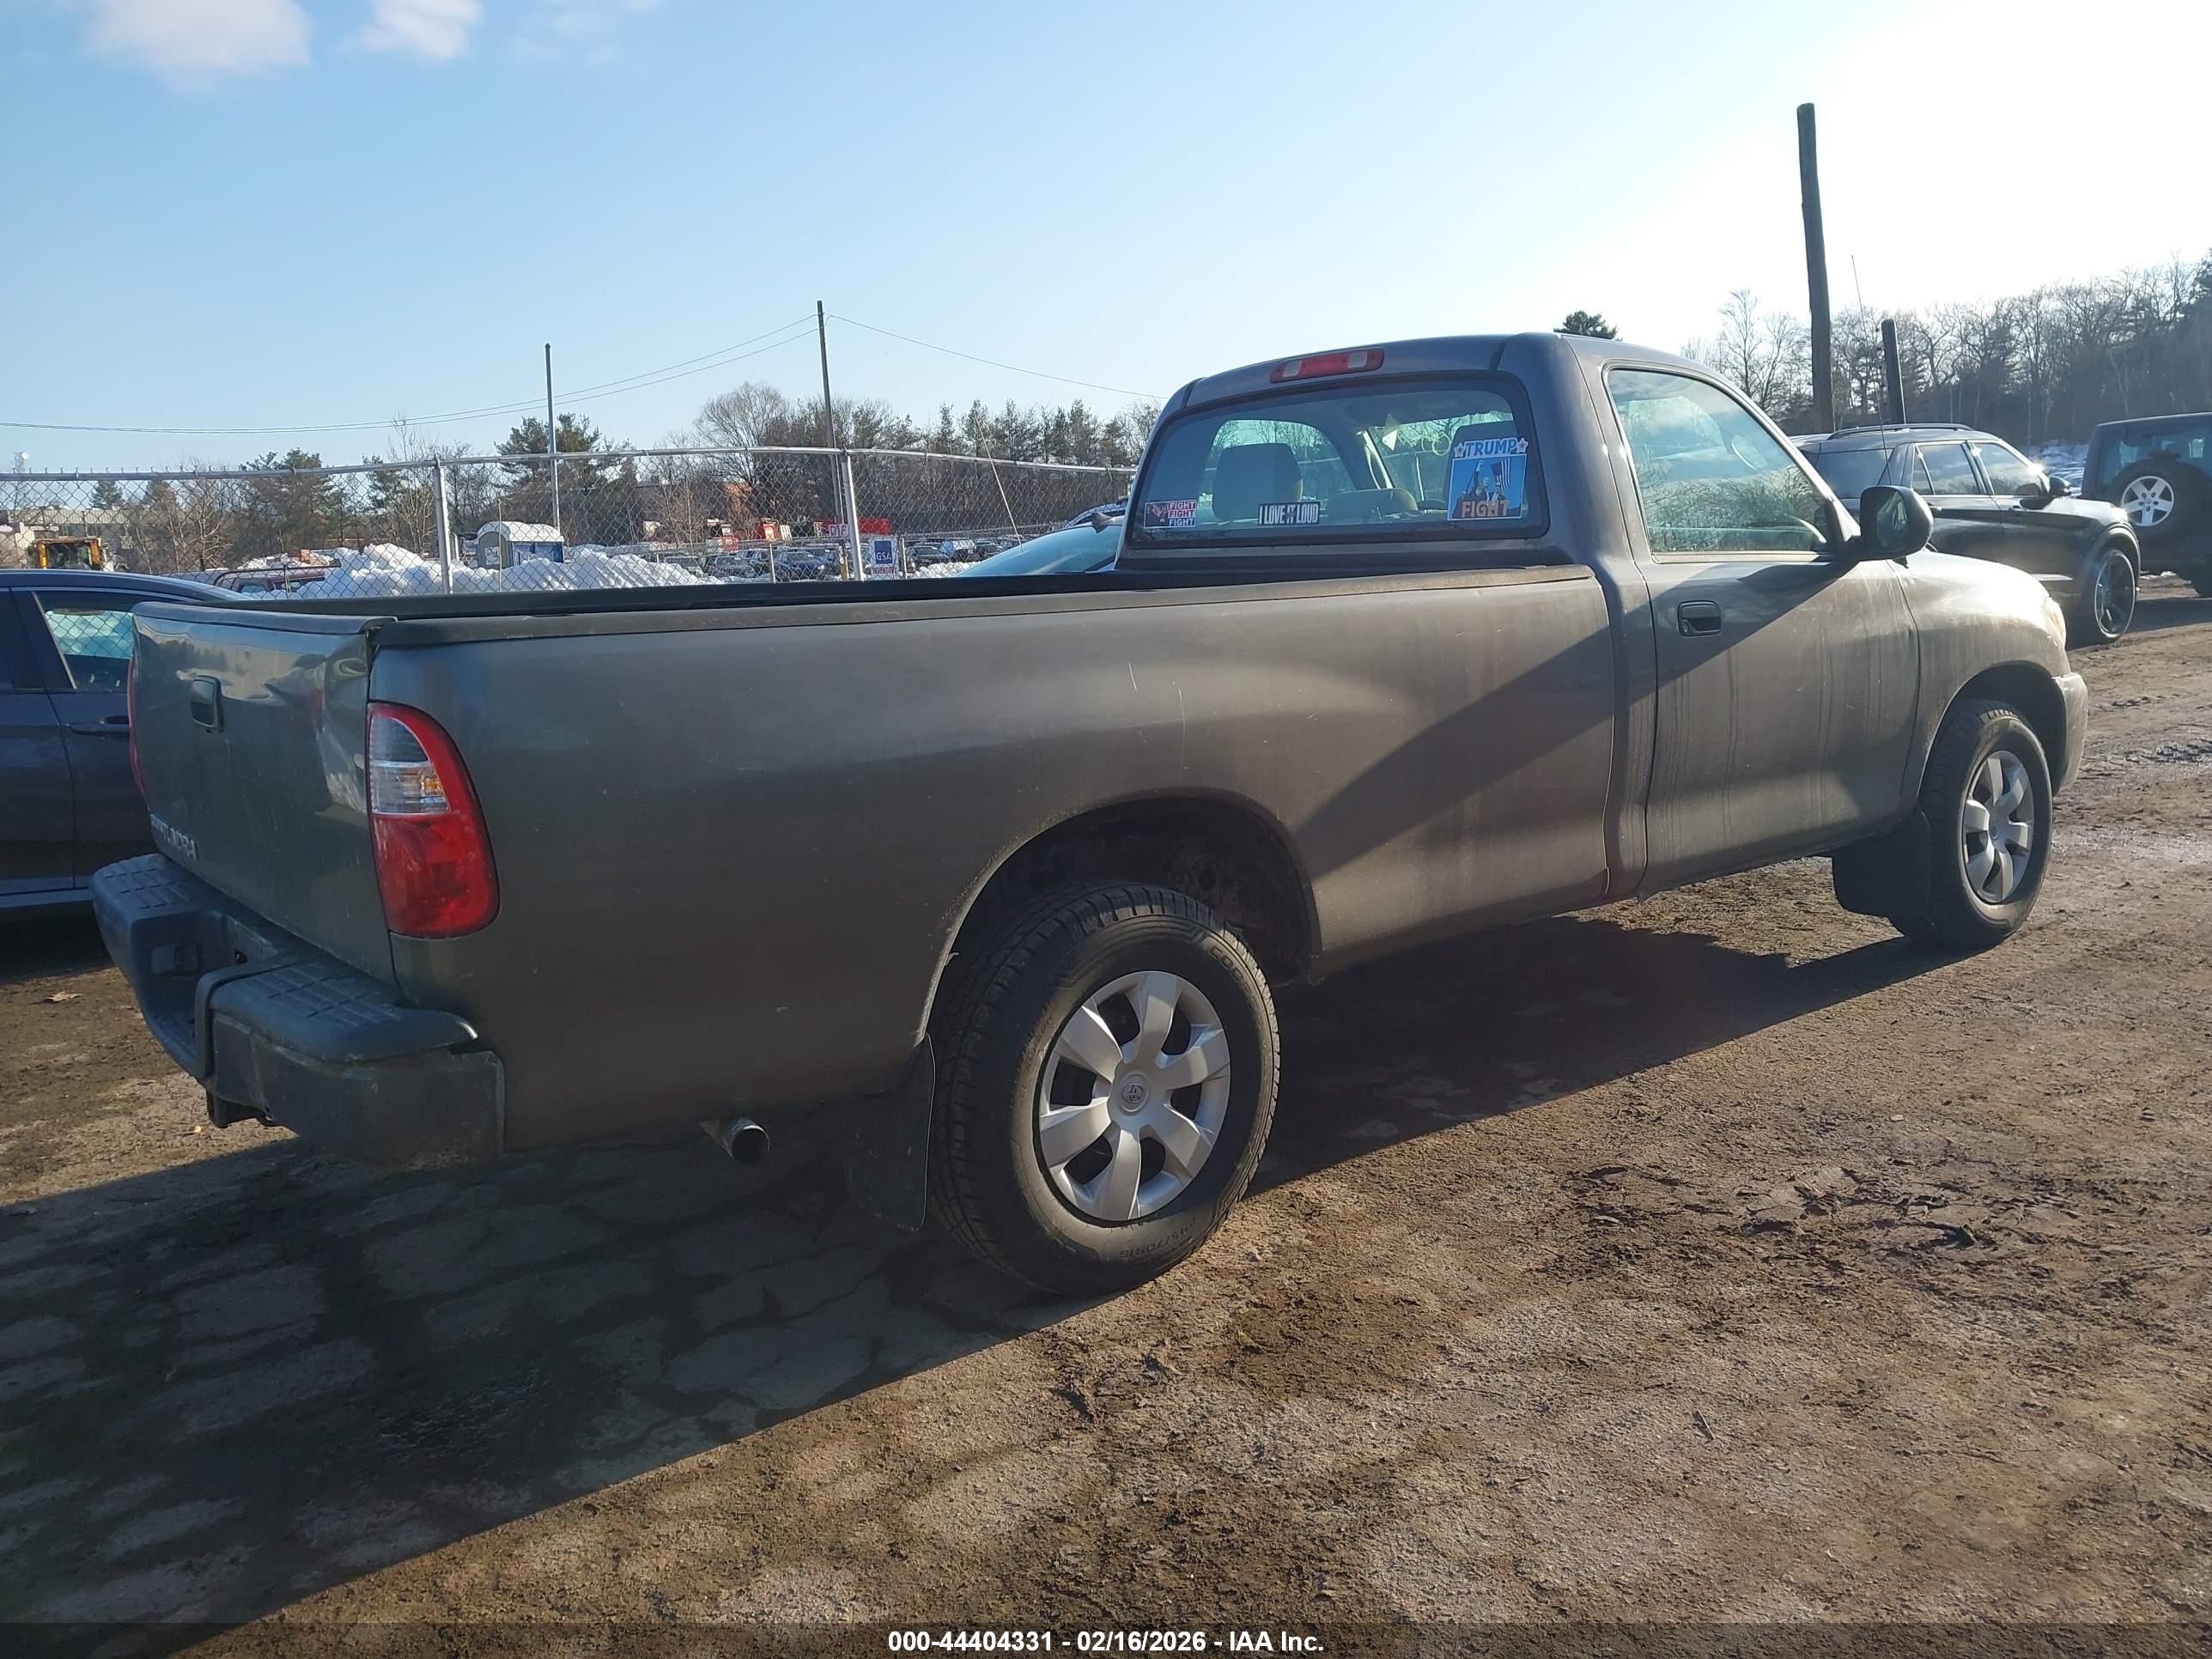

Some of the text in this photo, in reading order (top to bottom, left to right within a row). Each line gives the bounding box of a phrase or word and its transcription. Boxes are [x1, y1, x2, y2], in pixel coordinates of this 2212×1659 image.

[1464, 438, 1517, 458] TRUMP
[1170, 501, 1195, 510] FIGHT
[1462, 500, 1510, 518] FIGHT
[1169, 509, 1195, 518] FIGHT
[1259, 505, 1263, 525] I
[1264, 504, 1285, 524] LOVE
[1296, 503, 1319, 523] LOUD
[1169, 518, 1194, 526] FIGHT
[876, 552, 891, 561] GSA
